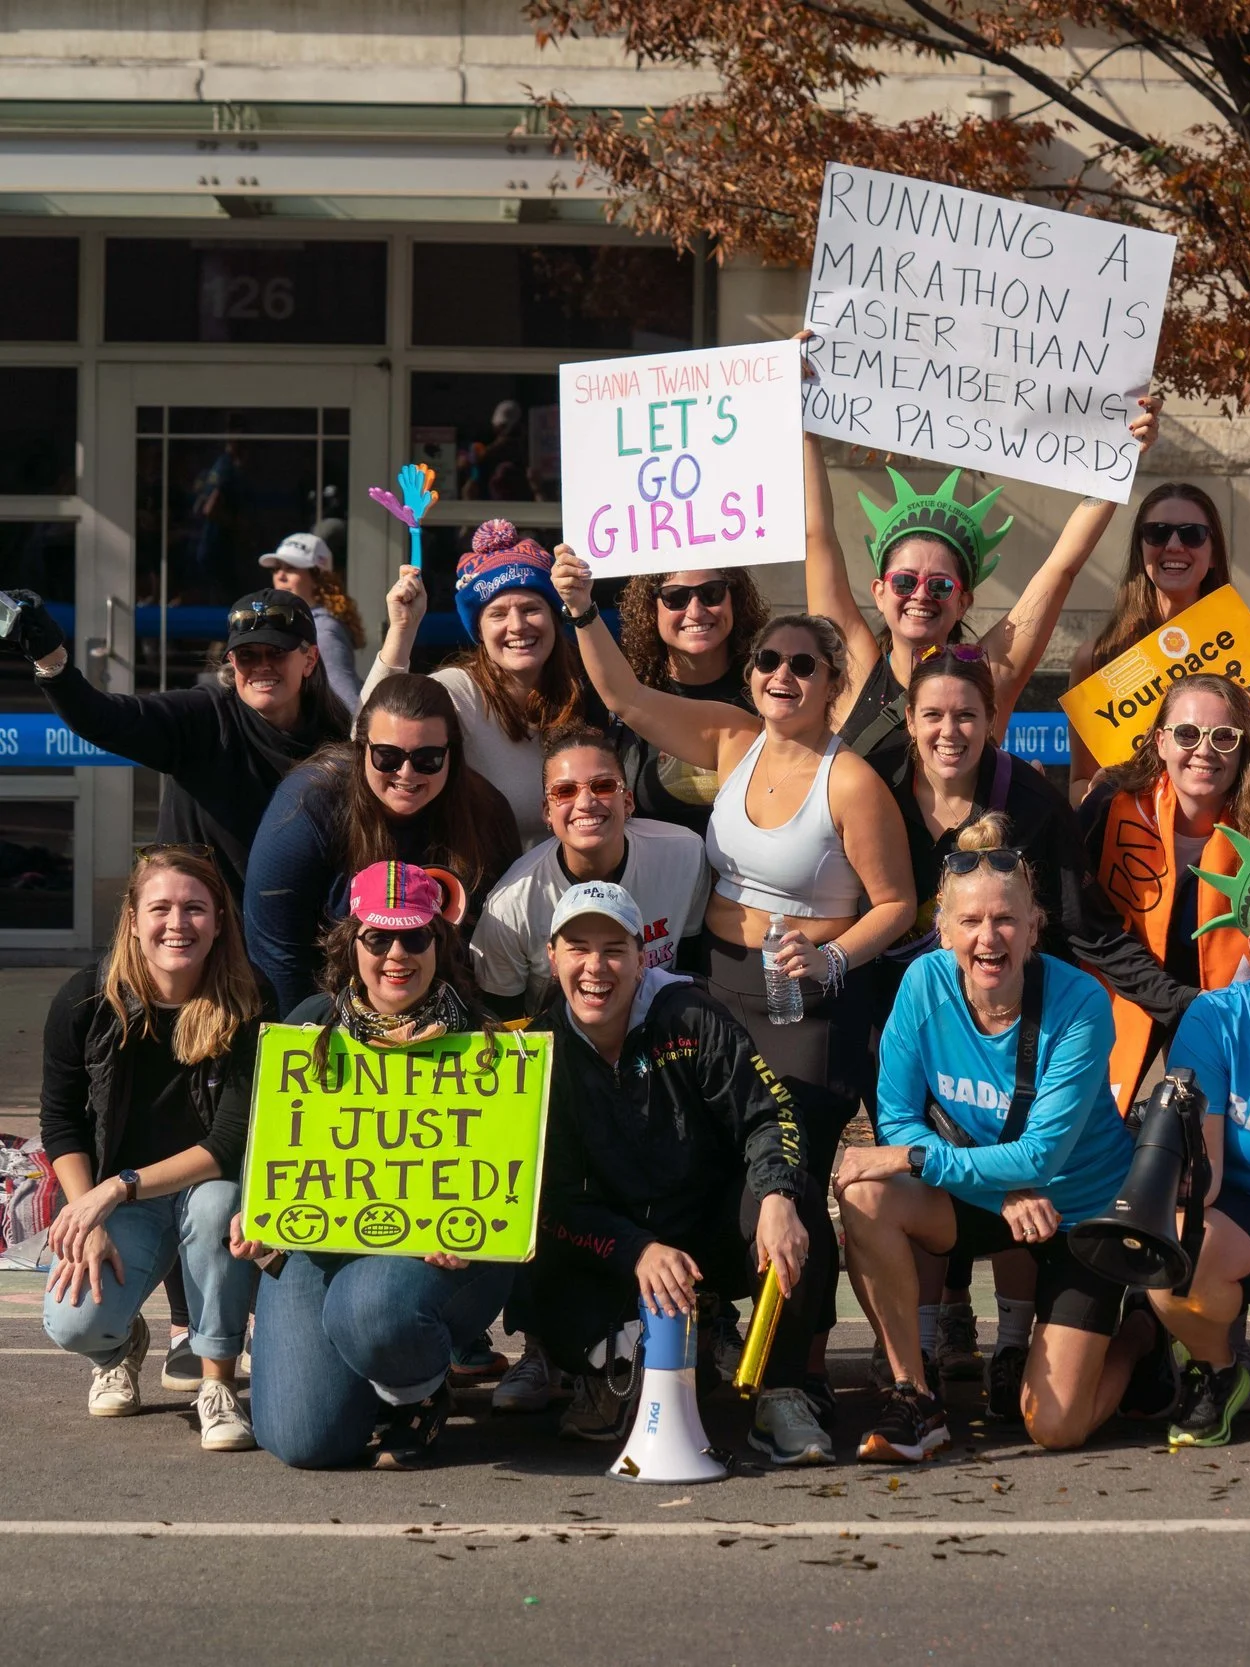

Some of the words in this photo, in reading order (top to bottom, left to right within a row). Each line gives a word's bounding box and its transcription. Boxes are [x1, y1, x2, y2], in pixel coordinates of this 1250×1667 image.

[829, 171, 1054, 259] RUNNING
[1098, 233, 1129, 282] A
[203, 277, 295, 319] 126
[817, 242, 1070, 324] MARATHON
[1102, 298, 1150, 340] IS
[809, 291, 958, 351] EASIER
[981, 323, 1110, 376] THAN
[575, 370, 641, 405] SHANIA
[648, 363, 710, 397] TWAIN
[719, 356, 784, 387] VOICE
[803, 334, 1128, 427] REMEMBERING
[616, 394, 738, 457] LET'S
[802, 383, 873, 435] YOUR
[896, 403, 1138, 482] PASSWORDS
[637, 453, 702, 503] GO
[587, 484, 766, 558] GIRLS!
[906, 500, 935, 511] STATUE
[936, 501, 947, 509] OF
[947, 505, 977, 528] LIBERTY
[473, 563, 536, 601] Brooklyn
[1094, 678, 1169, 729] Your
[1165, 629, 1236, 682] pace
[1016, 726, 1049, 753] NOT
[365, 912, 424, 926] BROOKLYN
[277, 1050, 390, 1096] RUN
[404, 1048, 539, 1097] FAST
[750, 1053, 792, 1103] NEW
[329, 1107, 483, 1150] JUST
[264, 1157, 525, 1205] FARTED!
[647, 1402, 660, 1435] PYLE
